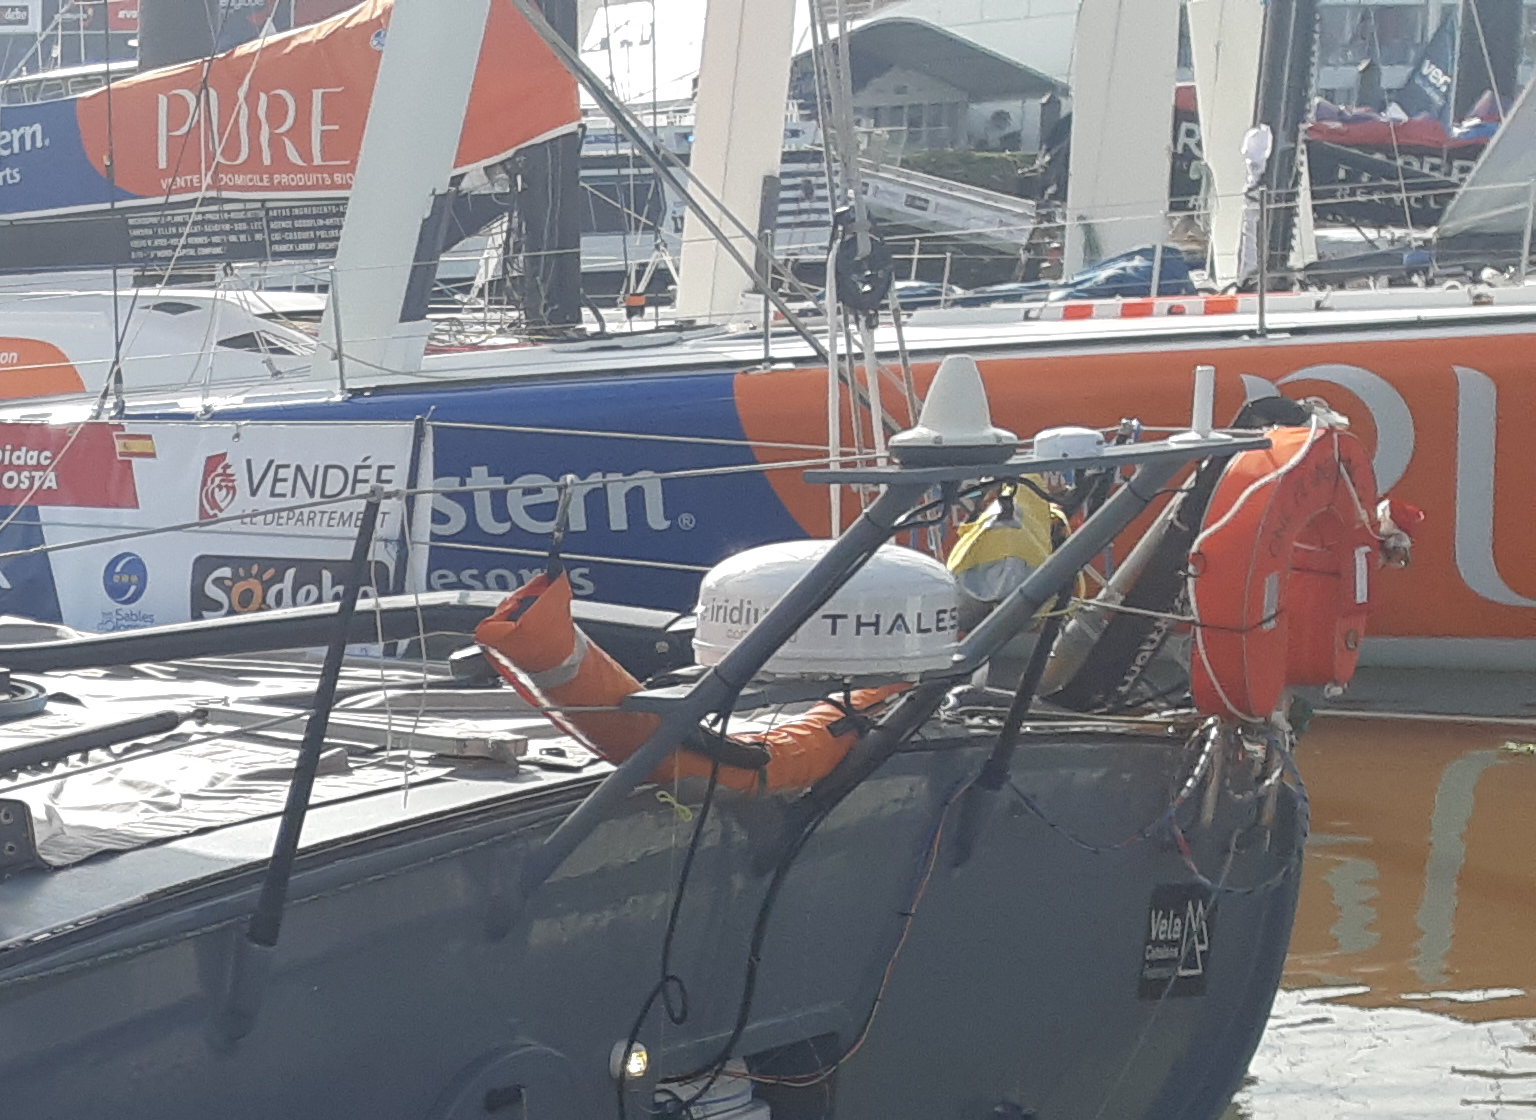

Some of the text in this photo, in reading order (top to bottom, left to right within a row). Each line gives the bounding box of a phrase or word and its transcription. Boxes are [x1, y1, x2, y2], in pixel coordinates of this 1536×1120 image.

[157, 86, 351, 169] PURE
[160, 176, 199, 191] VENTE
[273, 173, 332, 187] PRODUITS
[245, 456, 396, 499] VENDÉE
[240, 507, 391, 530] LE DÉPARTEMET
[820, 606, 960, 637] THALES
[1150, 909, 1183, 941] Vela
